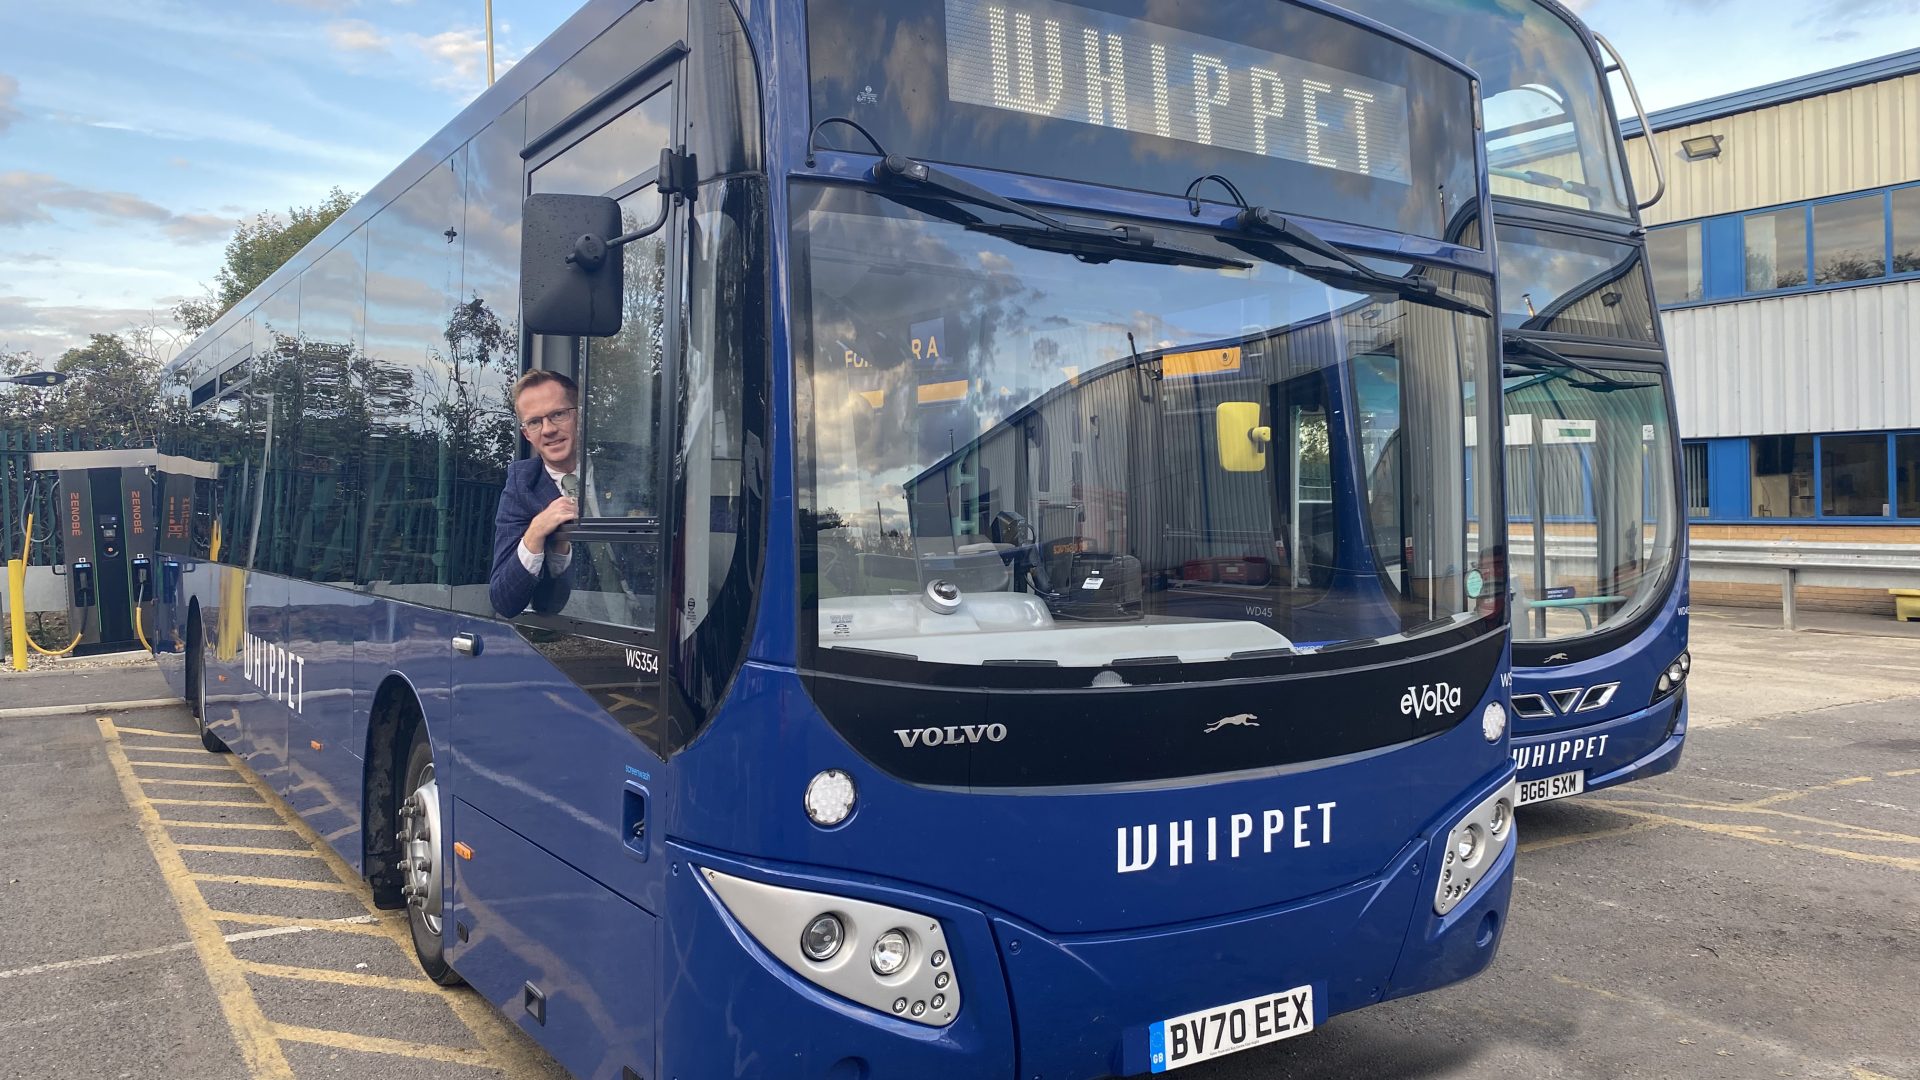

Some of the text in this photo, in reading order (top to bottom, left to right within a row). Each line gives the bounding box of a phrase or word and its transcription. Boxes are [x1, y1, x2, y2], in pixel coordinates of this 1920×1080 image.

[988, 5, 1374, 175] WHIPPET
[1245, 605, 1273, 618] WD45
[244, 631, 305, 714] WHIPPET
[625, 648, 659, 675] WS354
[893, 723, 1008, 748] VOLVO
[1512, 735, 1609, 770] WHIPPET
[1520, 774, 1577, 803] BG61 SXM
[1117, 801, 1337, 874] WHIPPET
[1170, 992, 1309, 1061] BV70 EEX
[1153, 1053, 1165, 1065] GB
